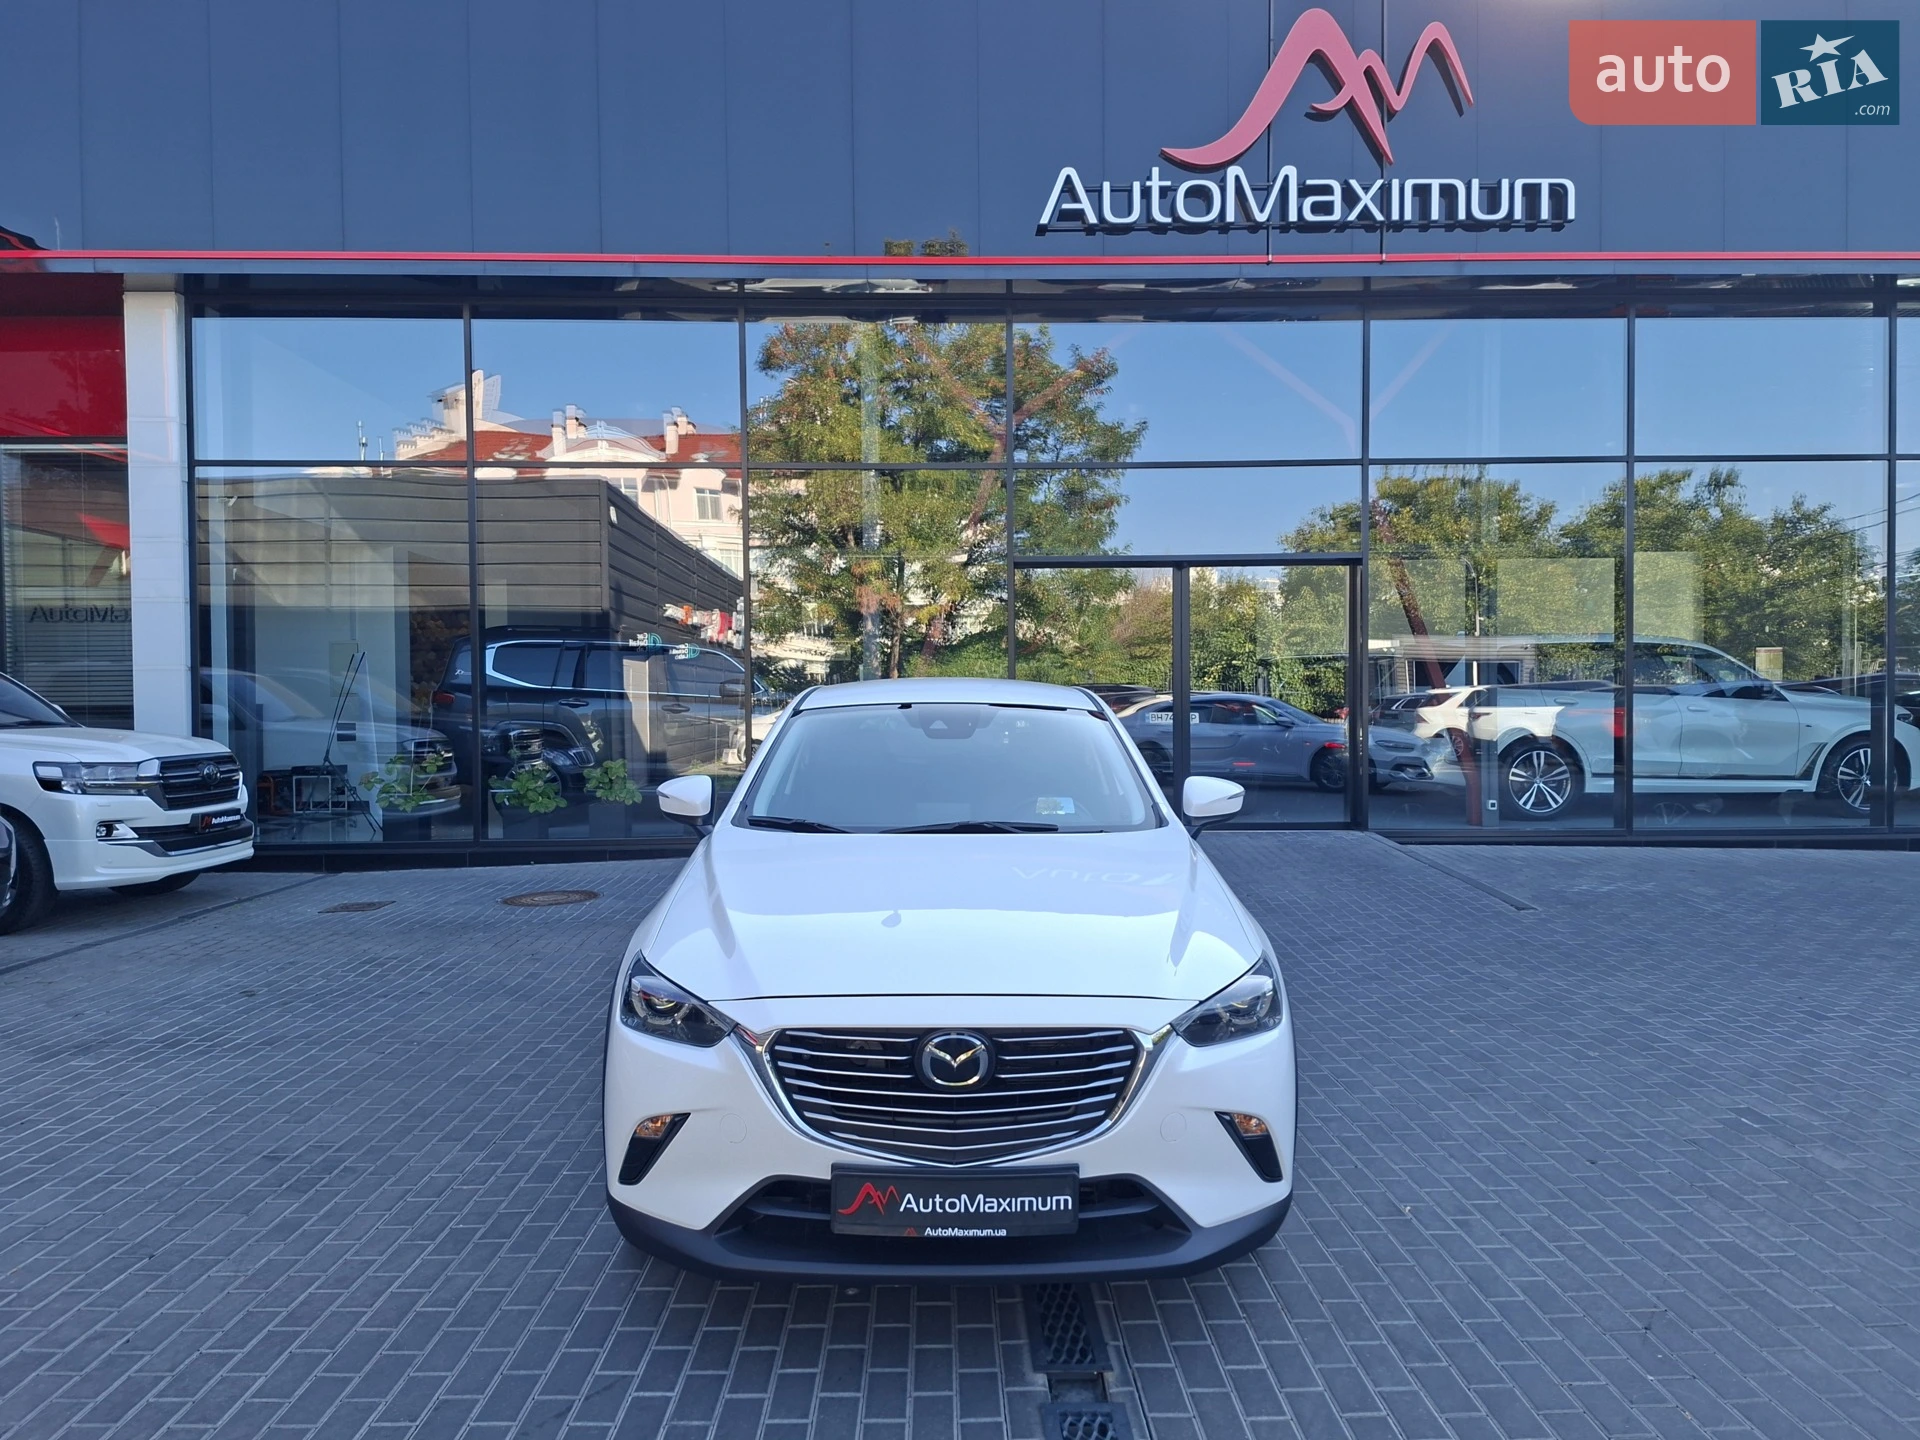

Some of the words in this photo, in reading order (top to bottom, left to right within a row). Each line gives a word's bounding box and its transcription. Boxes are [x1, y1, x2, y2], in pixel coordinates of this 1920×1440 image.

[1037, 164, 1576, 227] AutoMaximum
[29, 604, 131, 624] AutoMa
[1150, 713, 1163, 722] BH
[899, 1192, 1073, 1214] AutoMaximum
[924, 1226, 1007, 1237] AutoMaximum.ua
